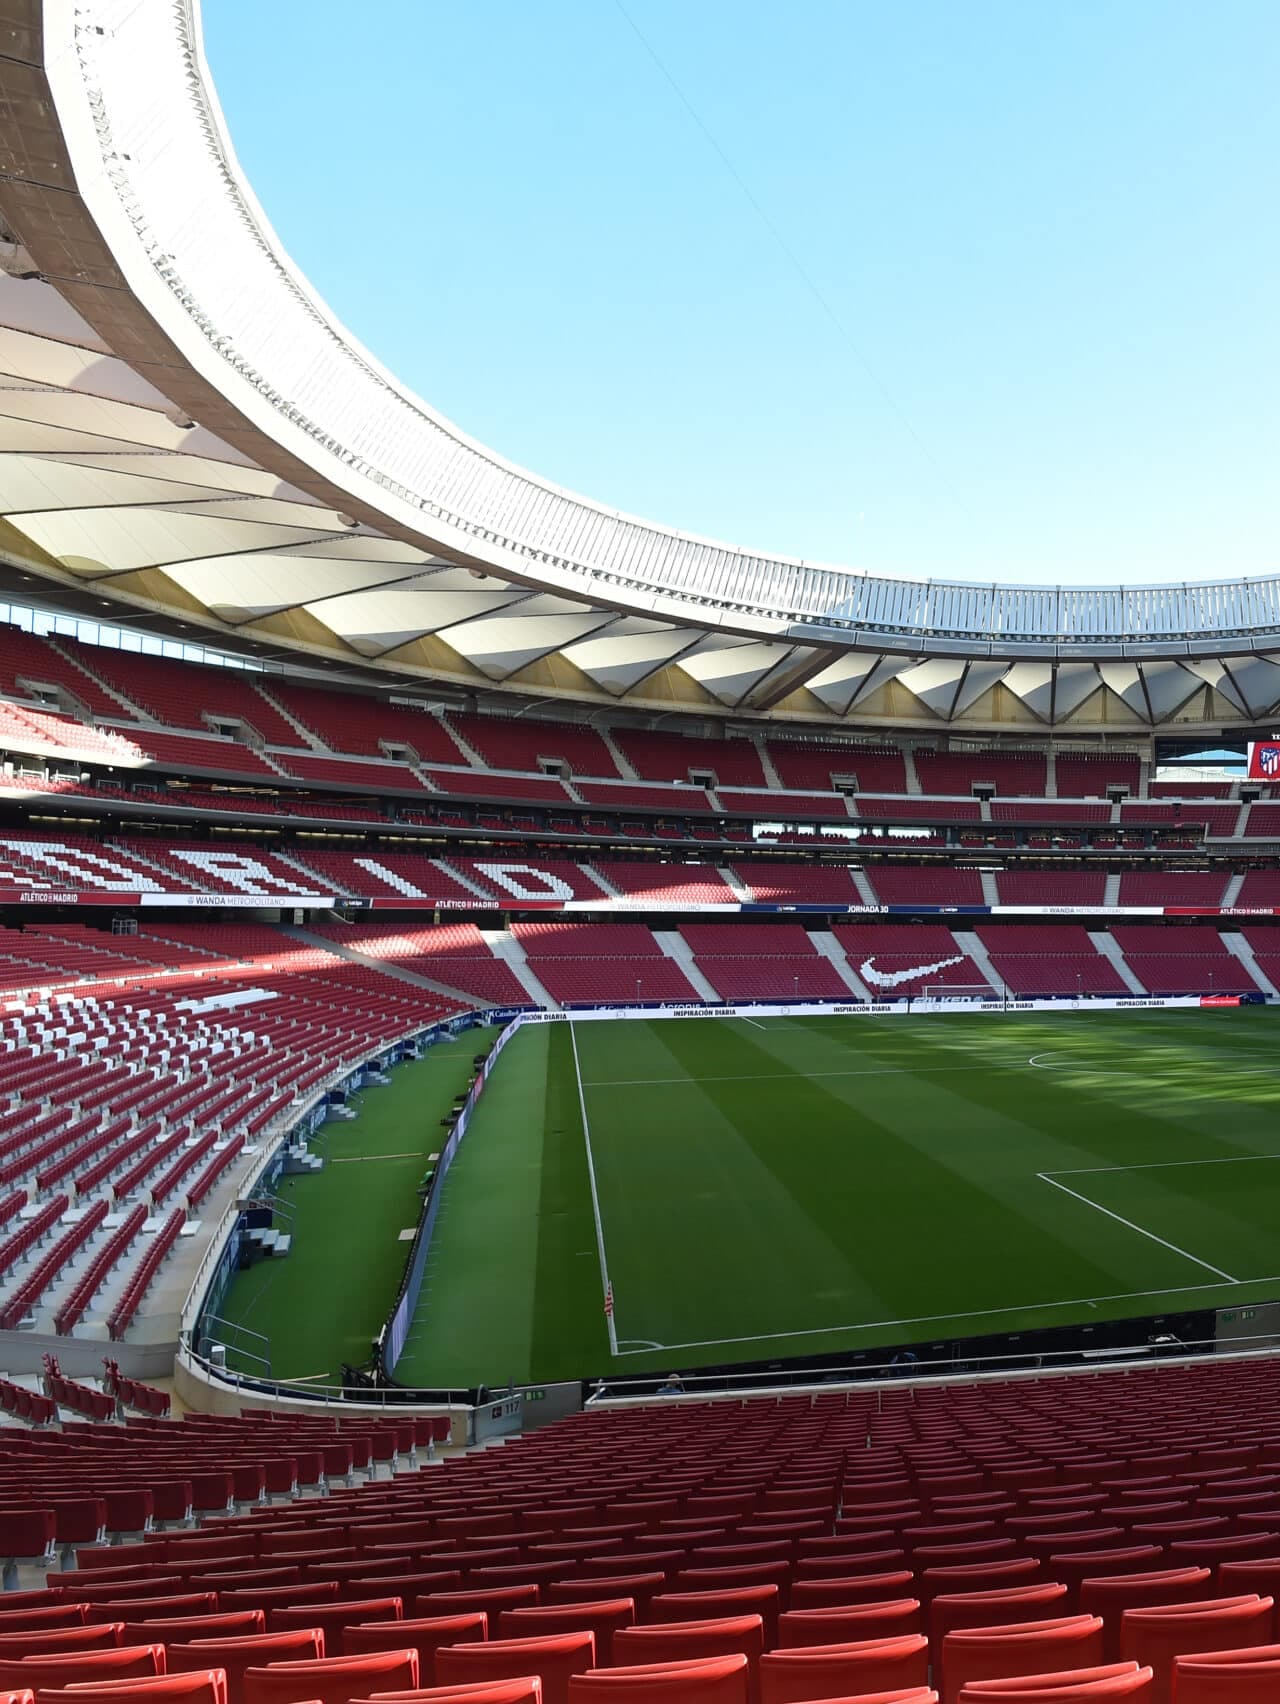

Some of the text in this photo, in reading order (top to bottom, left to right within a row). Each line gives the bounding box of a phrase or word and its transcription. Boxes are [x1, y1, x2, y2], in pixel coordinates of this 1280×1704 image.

[20, 891, 48, 902] ATLÉTICO
[53, 893, 78, 903] MADRID
[196, 896, 226, 905] WANDA
[435, 900, 466, 908] ATLÉTICO
[847, 905, 889, 913] JORNADA 30
[673, 1009, 713, 1017] INSPIRACIÓN
[833, 1005, 870, 1013] INSPIRACIÓN
